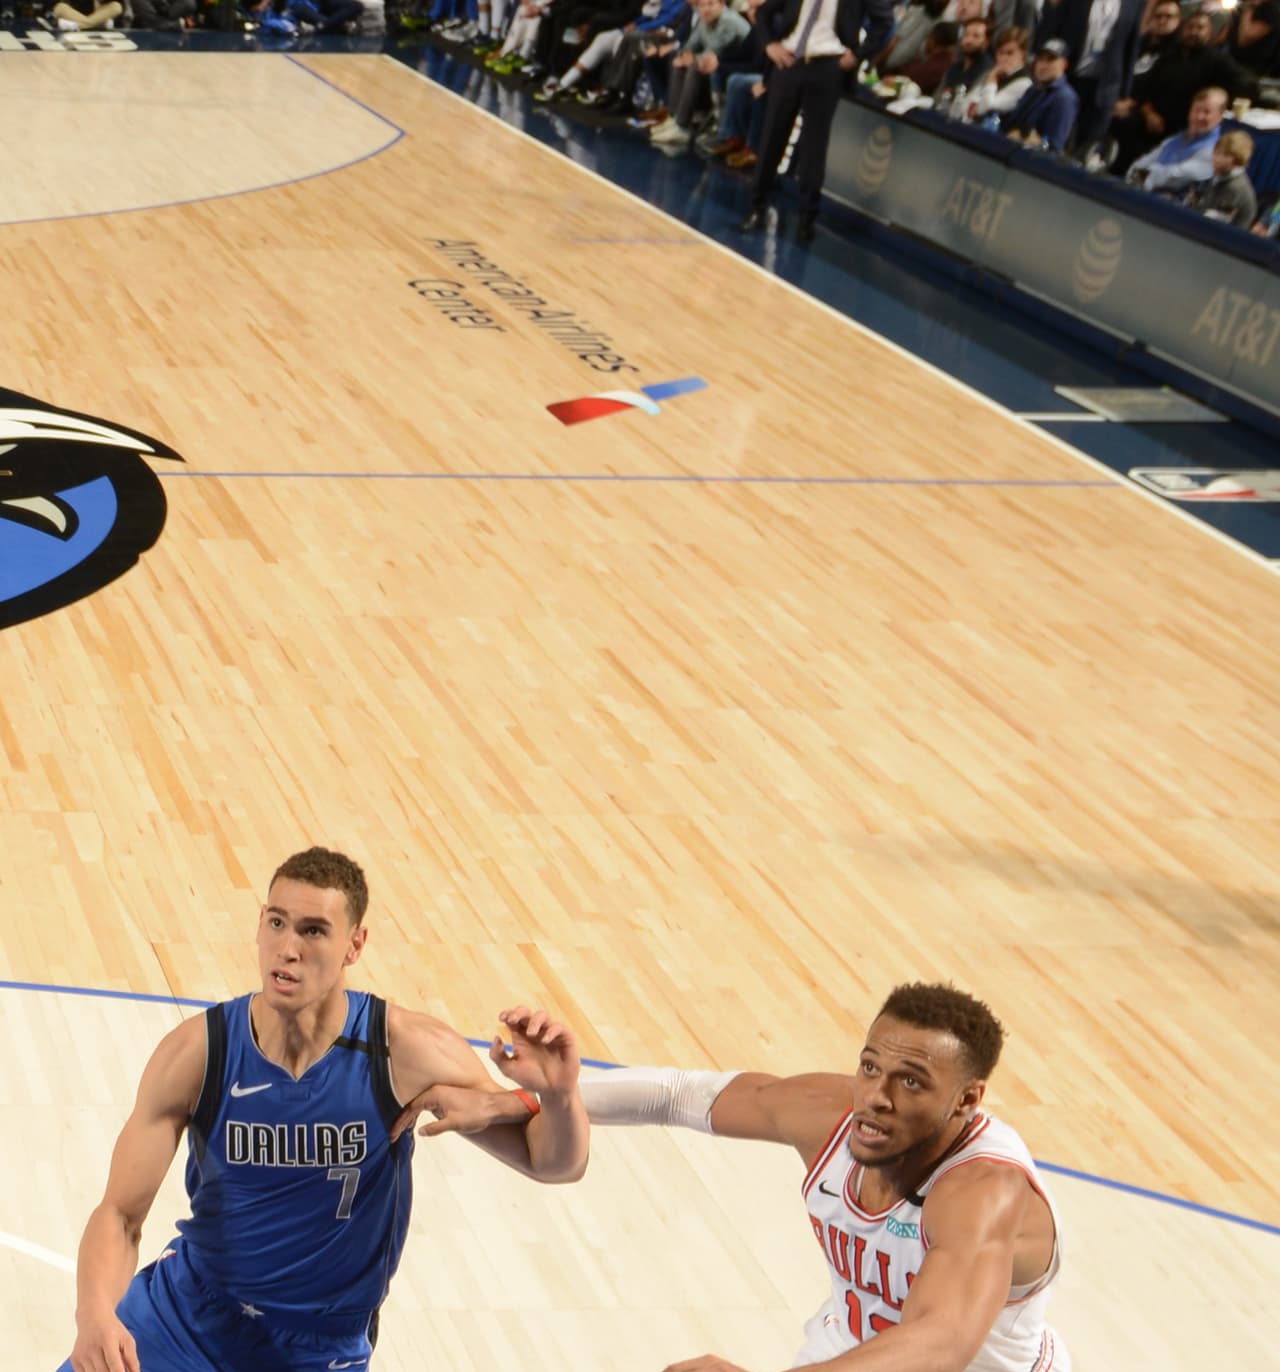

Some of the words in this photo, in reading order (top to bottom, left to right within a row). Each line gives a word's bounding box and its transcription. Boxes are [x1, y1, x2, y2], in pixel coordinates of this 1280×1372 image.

[944, 176, 1015, 241] AT&T
[407, 278, 507, 333] Center
[424, 237, 547, 306] American
[511, 308, 640, 373] Airlines
[1190, 286, 1280, 369] AT&T
[226, 1119, 367, 1169] DALLAS
[327, 1167, 362, 1220] 7
